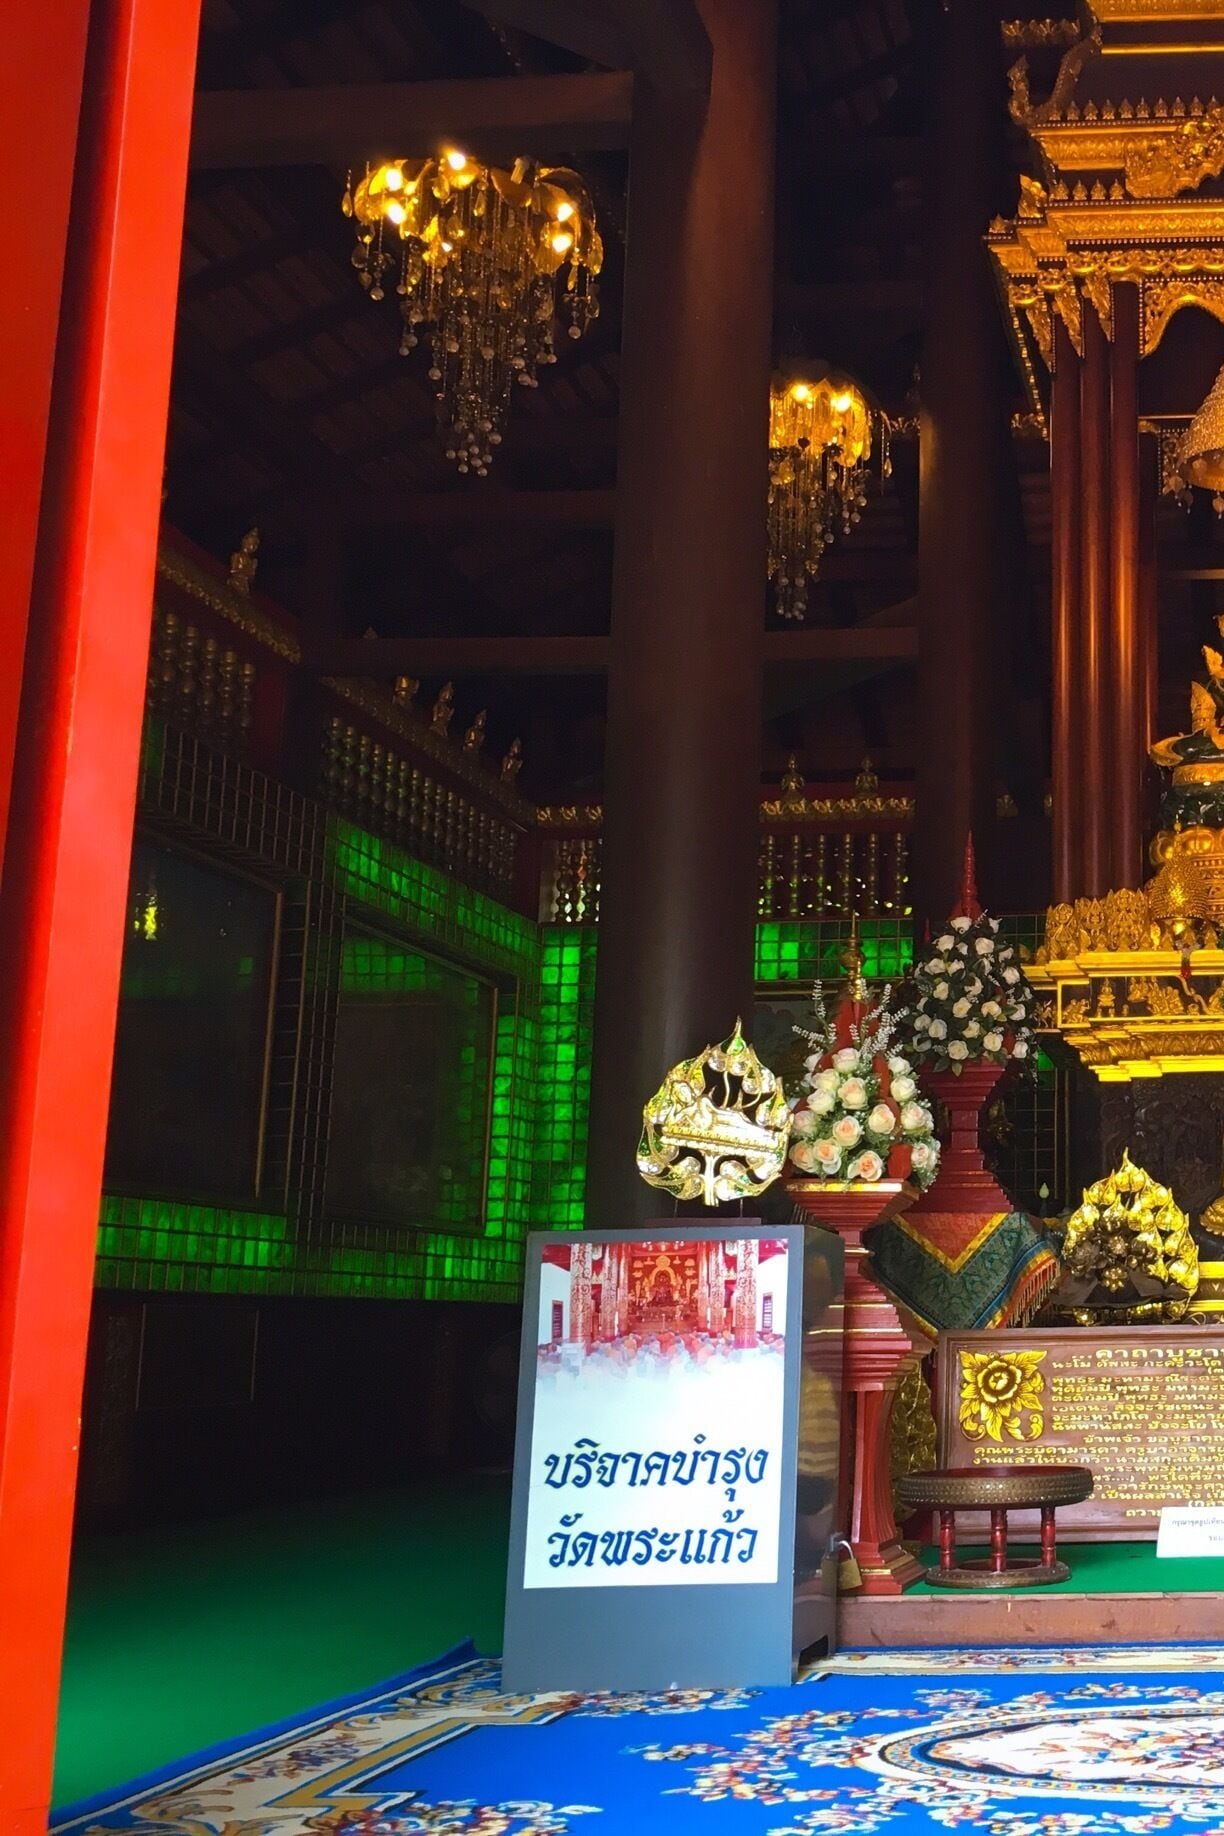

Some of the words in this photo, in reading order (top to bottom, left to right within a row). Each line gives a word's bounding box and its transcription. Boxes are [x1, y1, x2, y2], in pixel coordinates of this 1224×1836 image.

[543, 1432, 769, 1502] บริจาคบำรุง
[546, 1508, 759, 1569] วัดพระแก้ว
